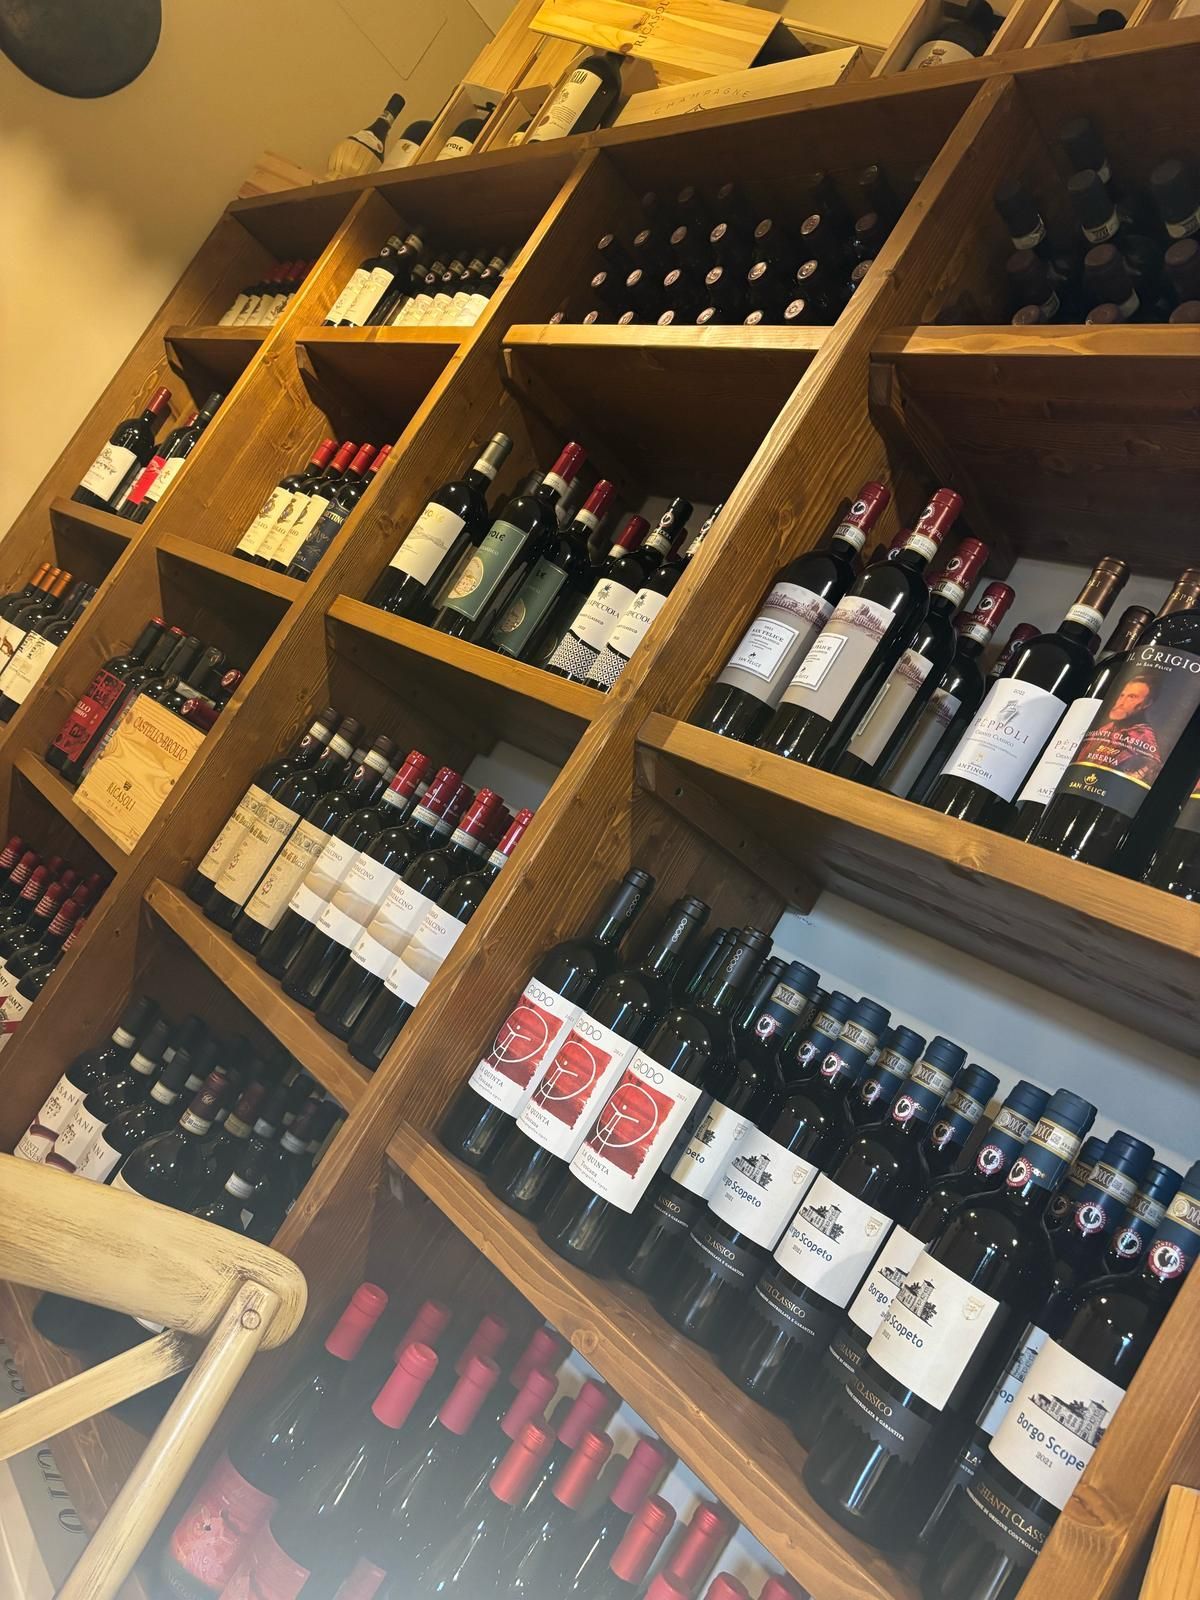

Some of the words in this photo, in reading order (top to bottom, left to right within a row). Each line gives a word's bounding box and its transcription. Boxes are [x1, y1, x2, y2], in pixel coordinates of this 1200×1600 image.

[1140, 647, 1200, 675] GRIGIO
[974, 717, 1030, 745] PEPPOLI
[957, 762, 993, 780] ANTINORI
[106, 781, 137, 813] RICASOLI
[1068, 780, 1082, 790] SAN
[1082, 784, 1107, 797] FELICE
[671, 918, 688, 943] GIODO
[727, 949, 743, 973] GIODO
[527, 984, 555, 1007] GIODO
[484, 1069, 505, 1089] QUINTA
[633, 1058, 664, 1085] GIODO
[531, 1107, 551, 1127] QUINTA
[586, 1153, 610, 1176] QUINTA
[731, 1180, 762, 1208] Scopeto
[799, 1232, 834, 1263] Scopeto
[771, 1288, 806, 1320] CLASSICO
[868, 1282, 889, 1305] Borgo
[889, 1314, 924, 1350] Scopeto
[1016, 1410, 1046, 1443] Borgo
[1044, 1435, 1088, 1472] Scope
[1035, 1451, 1054, 1469] 2021
